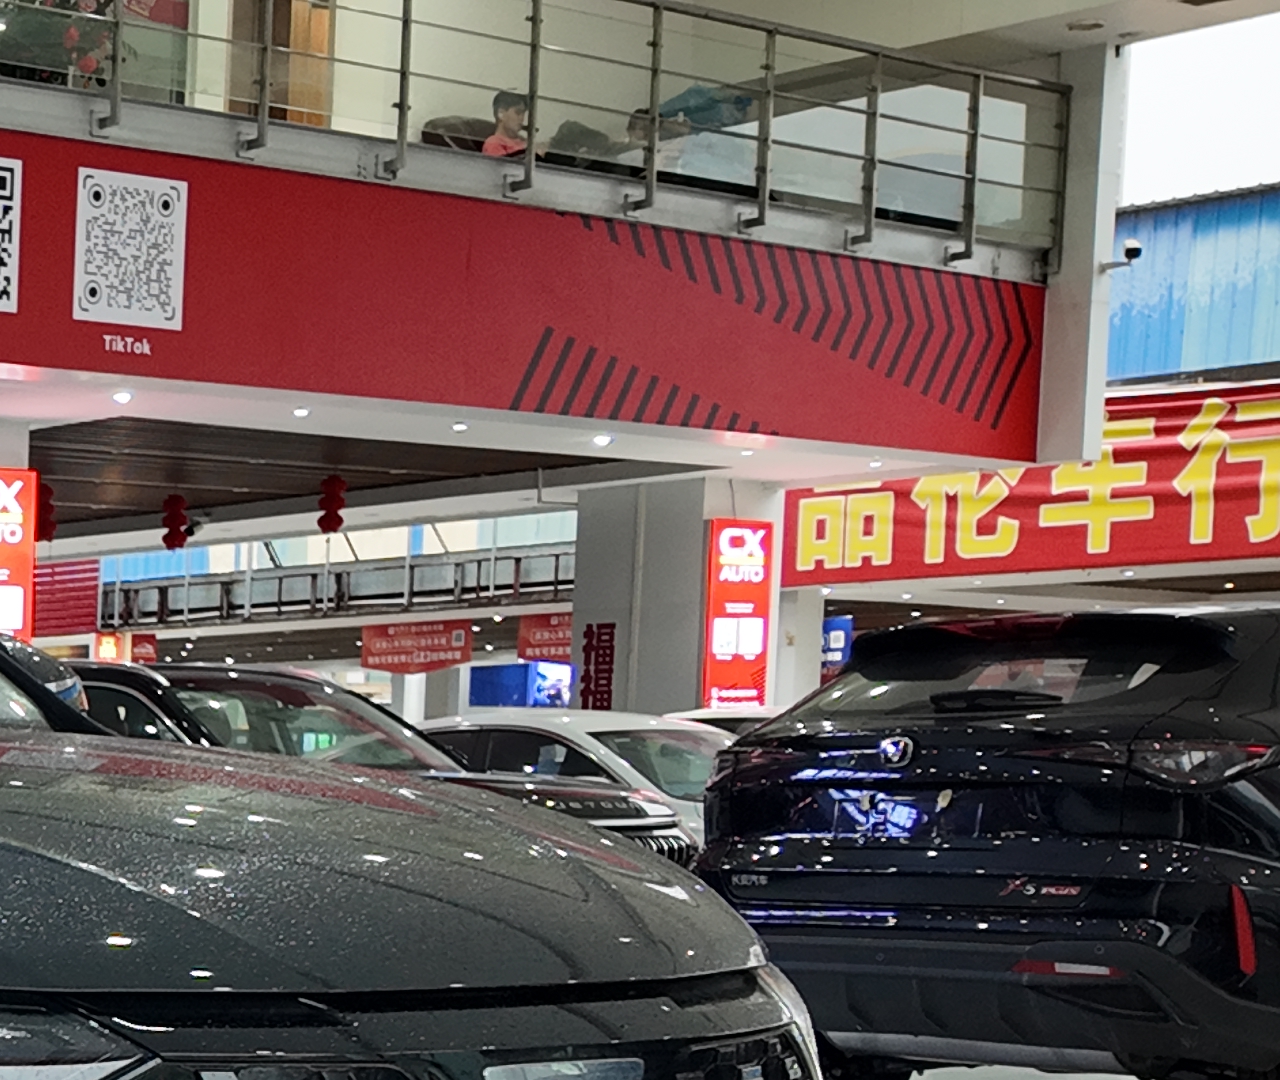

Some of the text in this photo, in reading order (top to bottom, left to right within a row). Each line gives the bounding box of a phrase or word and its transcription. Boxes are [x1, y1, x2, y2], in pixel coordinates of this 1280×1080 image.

[102, 334, 152, 356] TikTok
[719, 527, 768, 557] CX
[719, 565, 765, 583] AUTO
